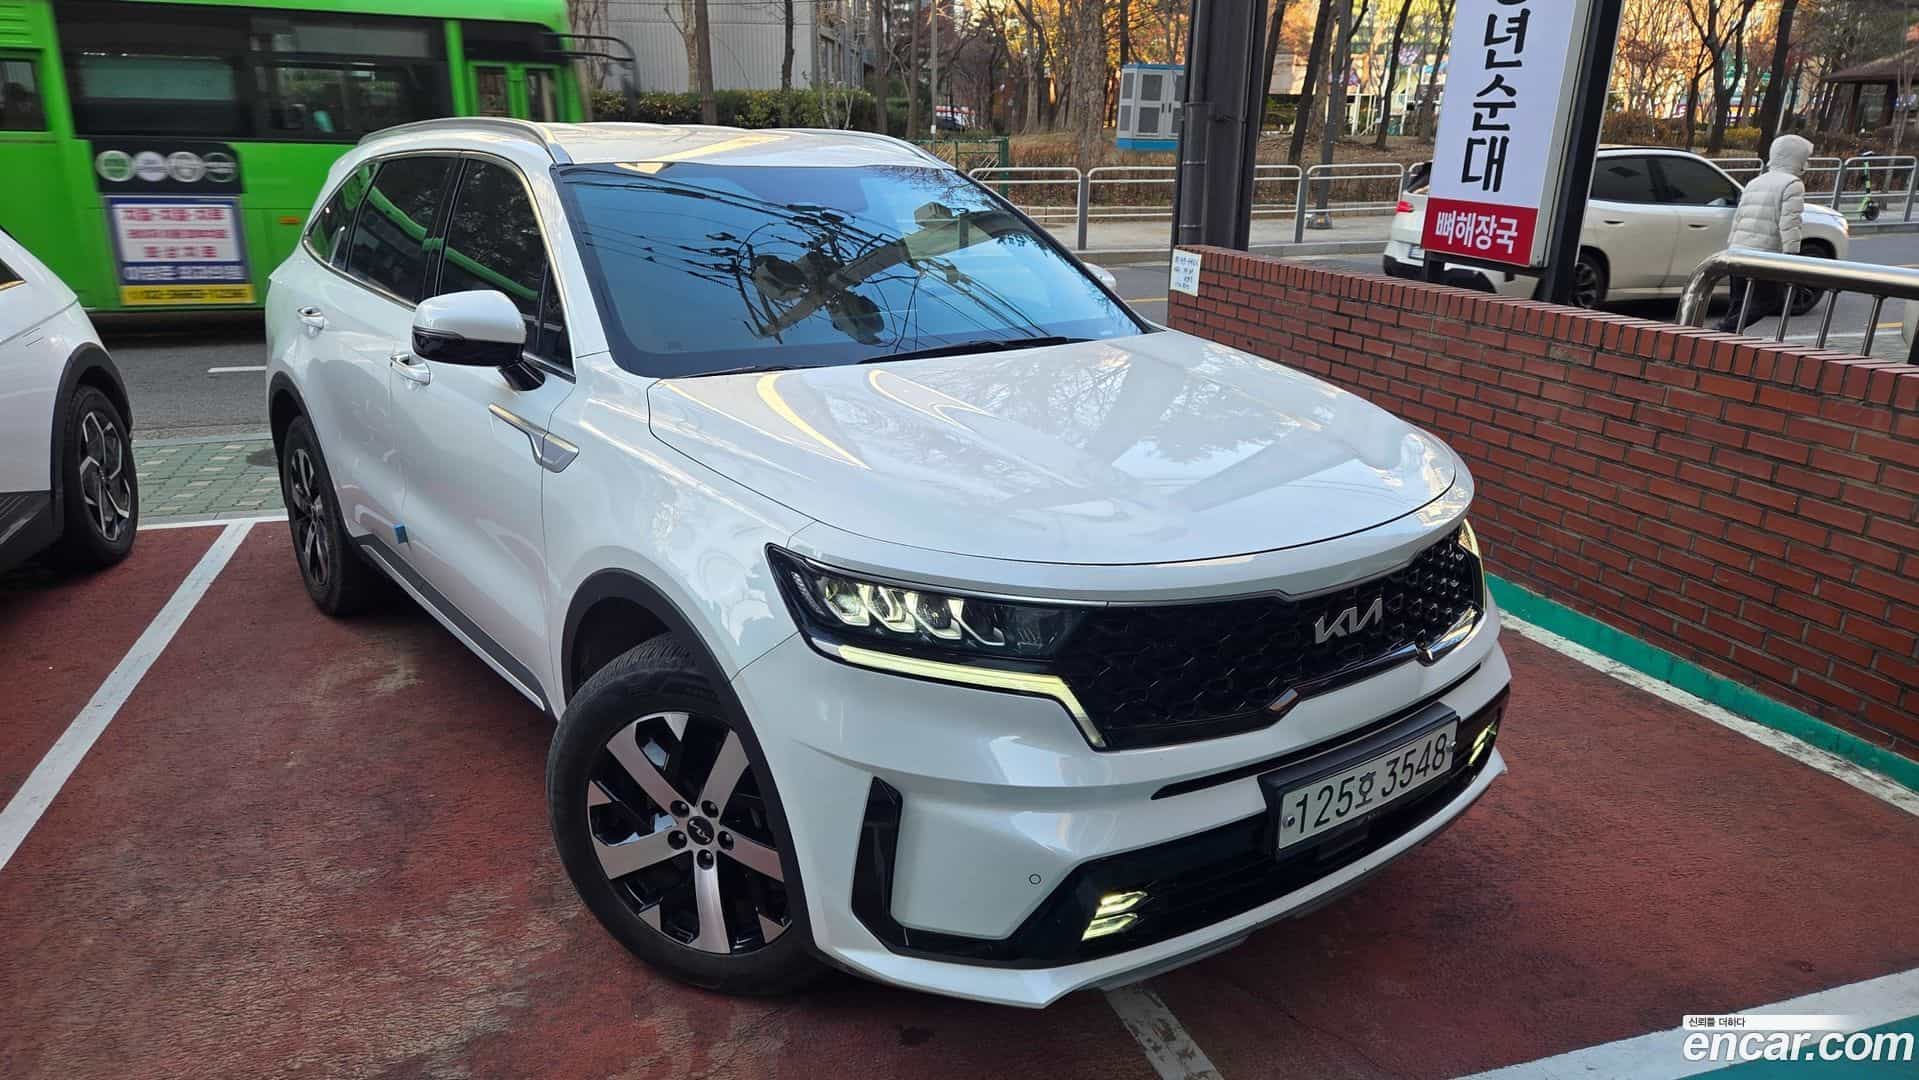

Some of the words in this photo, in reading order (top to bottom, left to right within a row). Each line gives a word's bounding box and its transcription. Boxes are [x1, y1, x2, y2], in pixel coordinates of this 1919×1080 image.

[1461, 0, 1530, 192] 년순대
[1435, 210, 1518, 254] 뼈해장국
[1315, 598, 1382, 644] KIA
[1382, 733, 1448, 797] 3548
